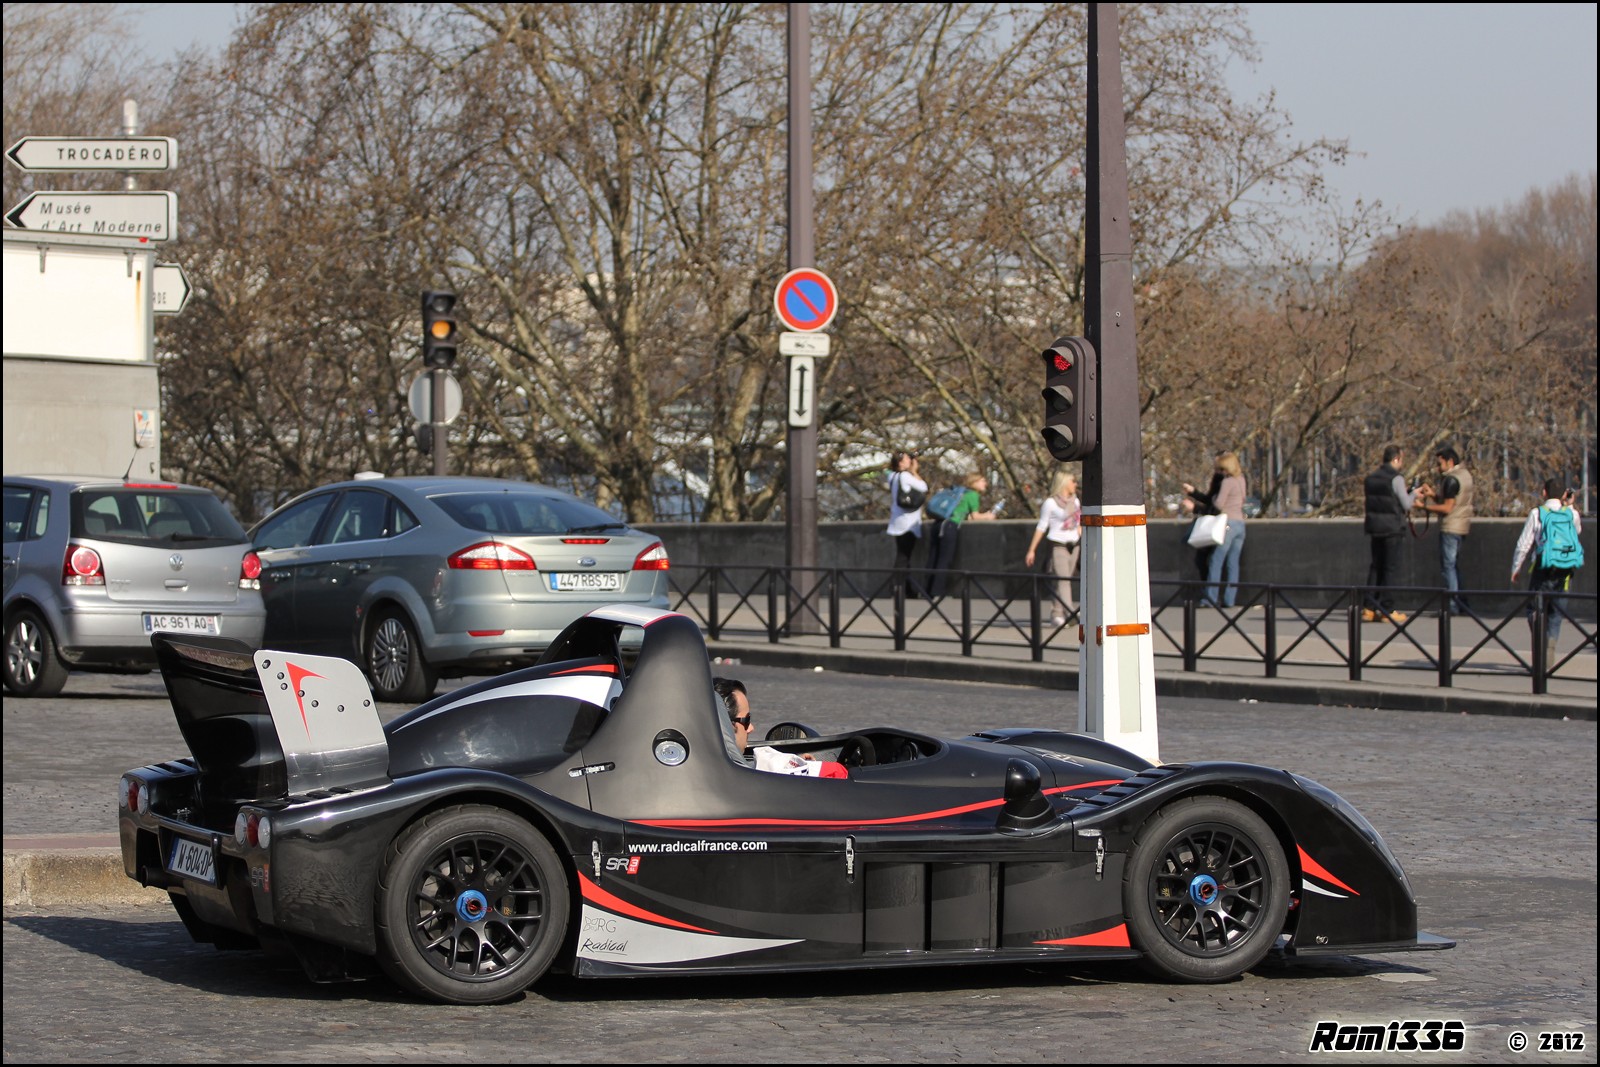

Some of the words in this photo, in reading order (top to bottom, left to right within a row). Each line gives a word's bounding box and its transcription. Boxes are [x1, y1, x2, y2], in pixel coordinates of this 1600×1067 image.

[57, 145, 163, 161] TROCADÉRO
[40, 202, 92, 214] Musée
[93, 221, 162, 233] Moderne
[560, 574, 579, 587] 447
[582, 574, 602, 587] RBS
[603, 574, 617, 587] 75
[628, 839, 768, 853] www.radicalfrance.com
[580, 937, 629, 953] Radical
